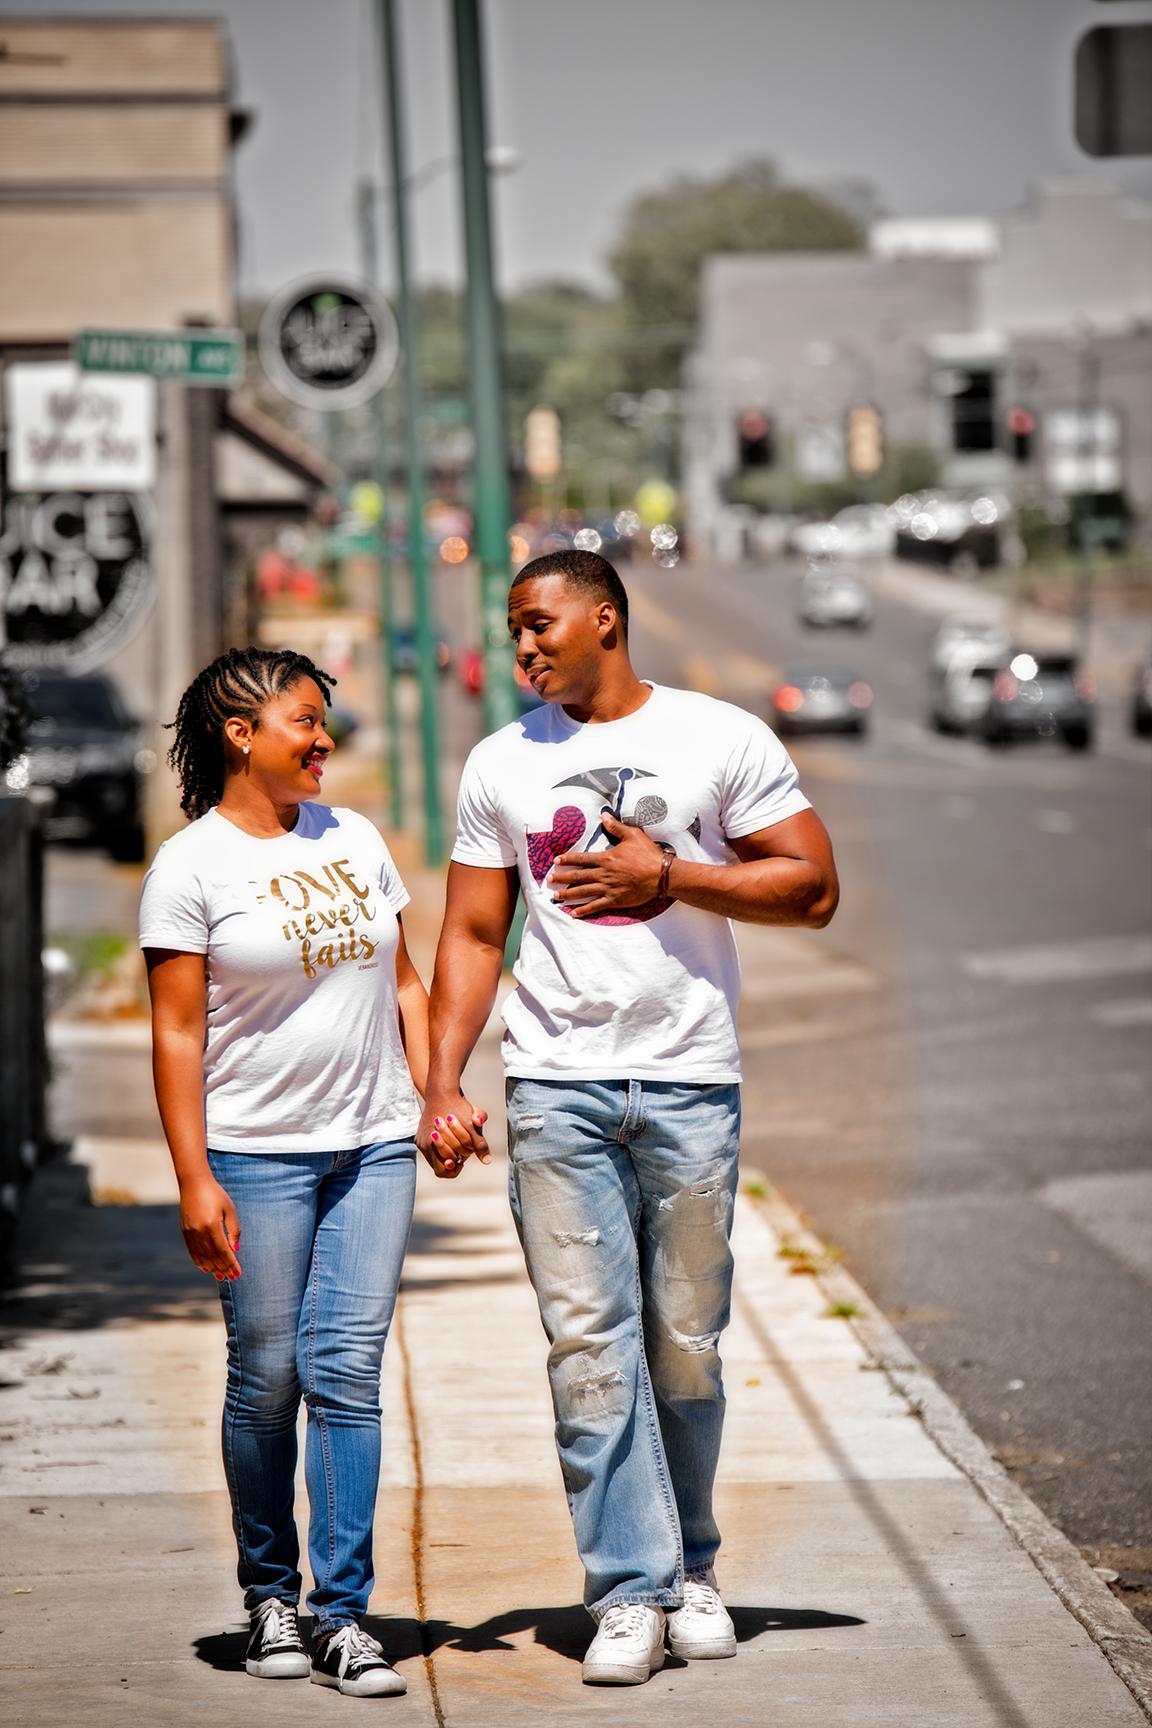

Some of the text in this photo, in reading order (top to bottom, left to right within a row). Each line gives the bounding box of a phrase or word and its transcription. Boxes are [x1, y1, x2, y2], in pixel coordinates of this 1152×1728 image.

[87, 340, 190, 370] VINTON
[0, 548, 101, 615] AR
[250, 859, 370, 911] OVE
[282, 898, 376, 941] never
[301, 928, 379, 980] fails
